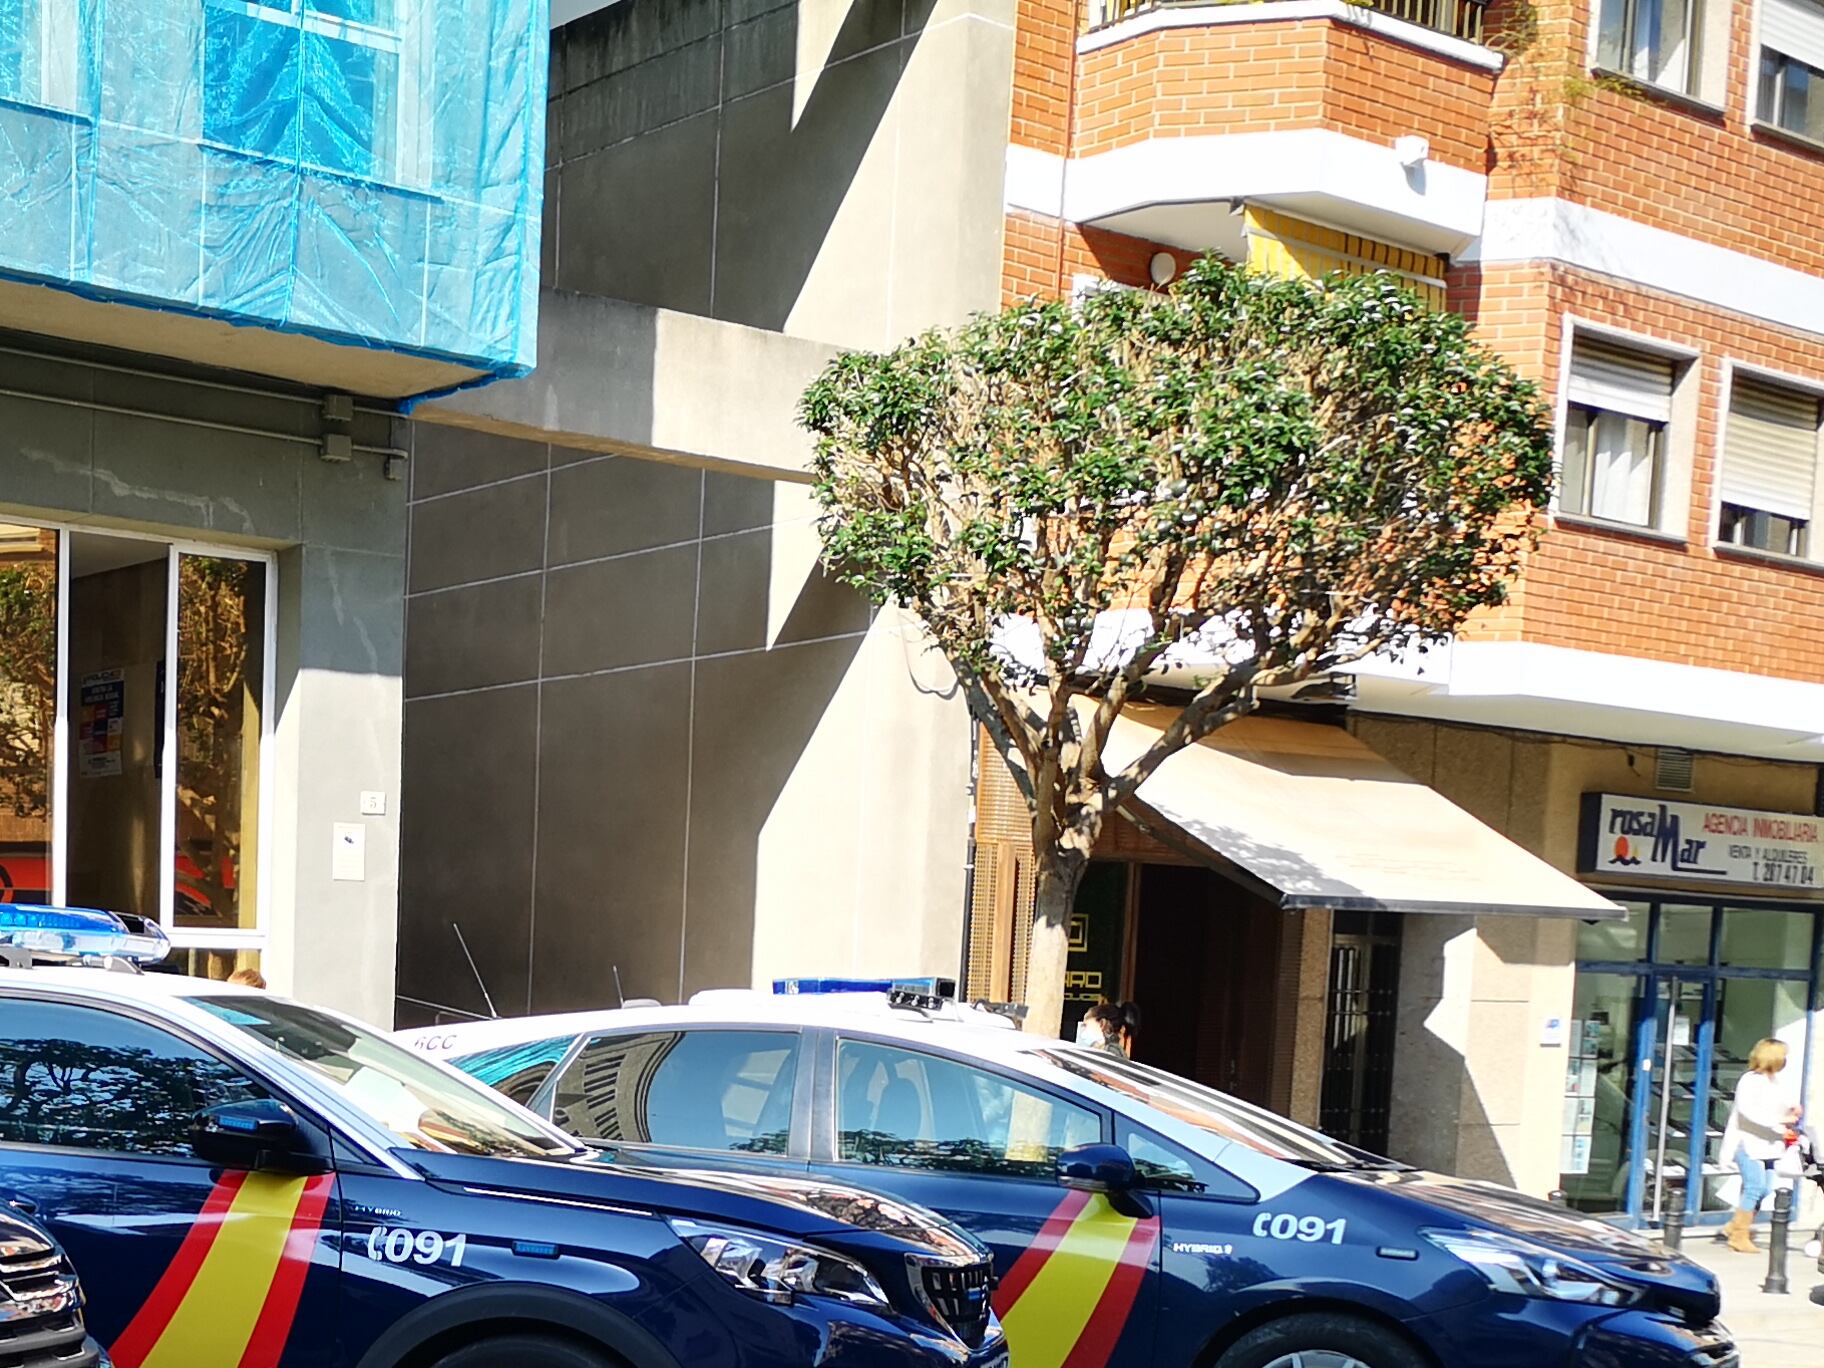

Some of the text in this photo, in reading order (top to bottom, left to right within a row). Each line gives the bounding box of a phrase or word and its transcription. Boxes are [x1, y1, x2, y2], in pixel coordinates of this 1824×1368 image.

[1703, 812, 1818, 842] AGENCIA INMOBILIARIA
[1270, 1213, 1347, 1245] 091
[384, 1228, 467, 1267] 091
